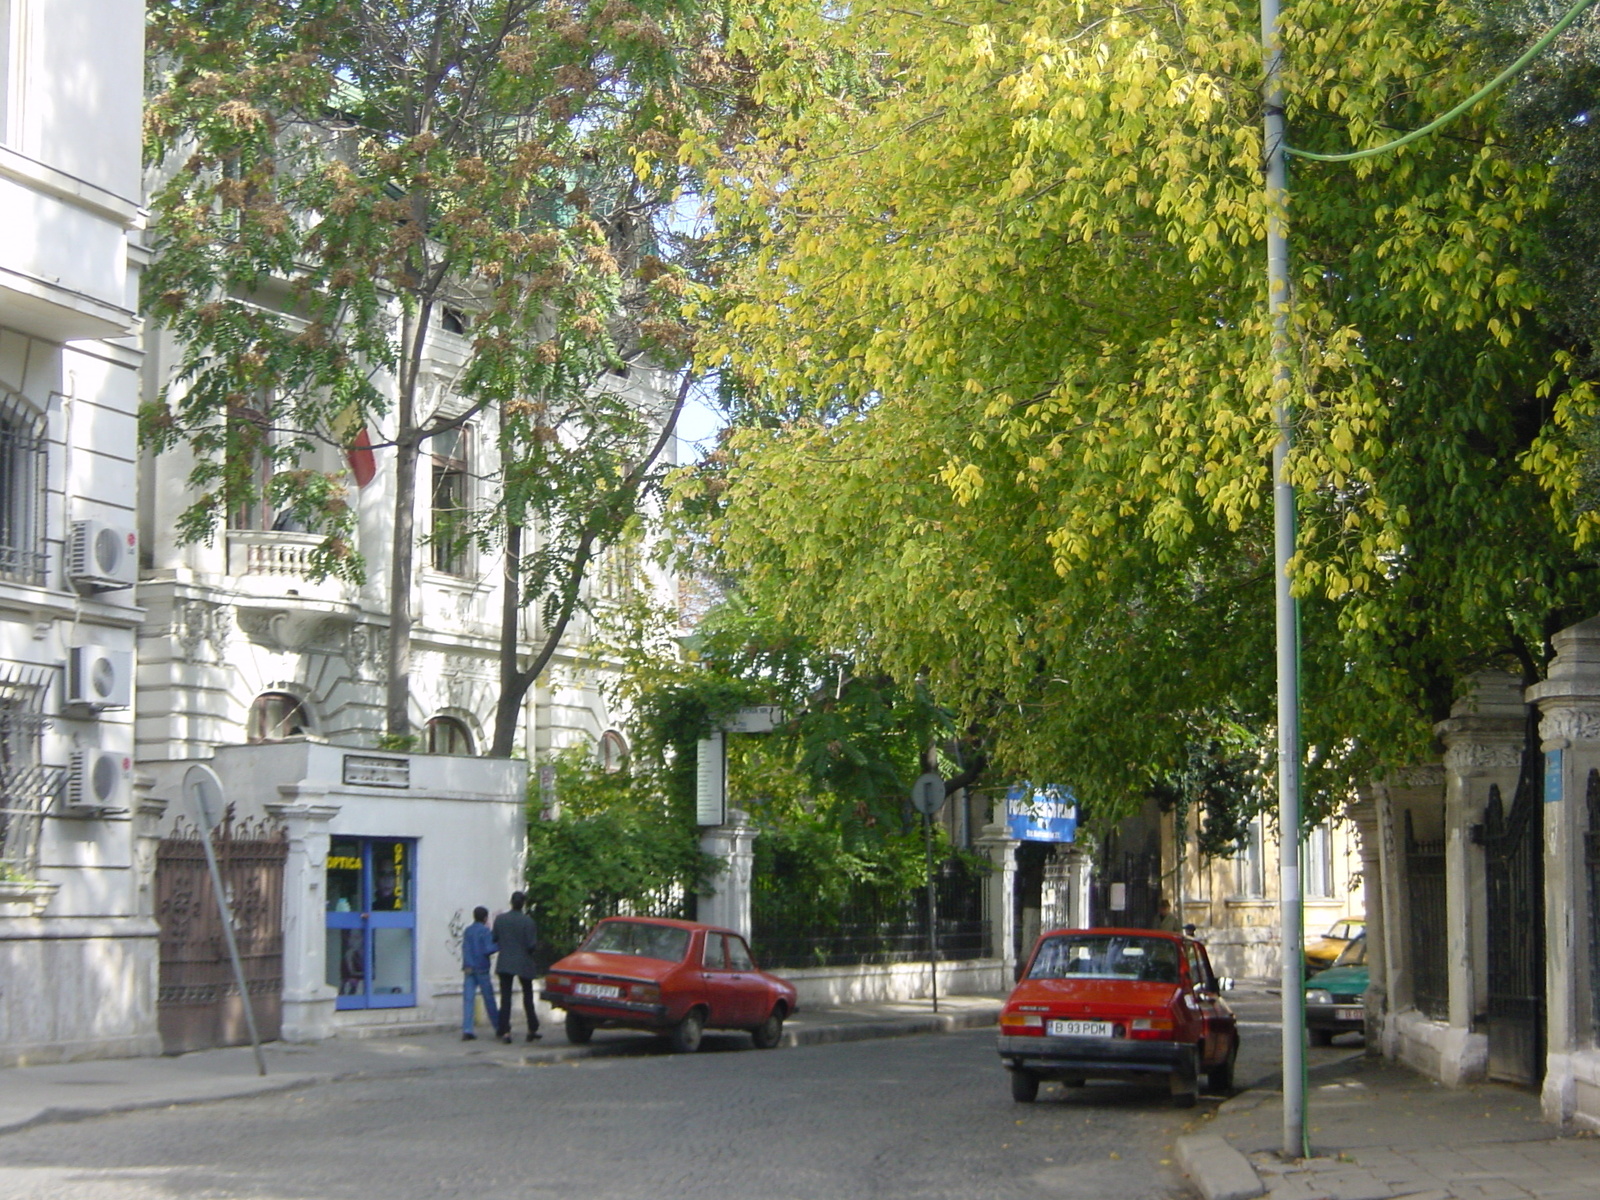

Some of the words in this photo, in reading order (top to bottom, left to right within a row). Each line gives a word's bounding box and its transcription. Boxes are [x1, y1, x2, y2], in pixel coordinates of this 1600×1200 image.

[326, 855, 362, 870] OPTICA
[394, 843, 403, 909] OPTICA
[1055, 1022, 1063, 1033] B
[1067, 1023, 1080, 1034] 93
[1082, 1023, 1106, 1035] PDM
